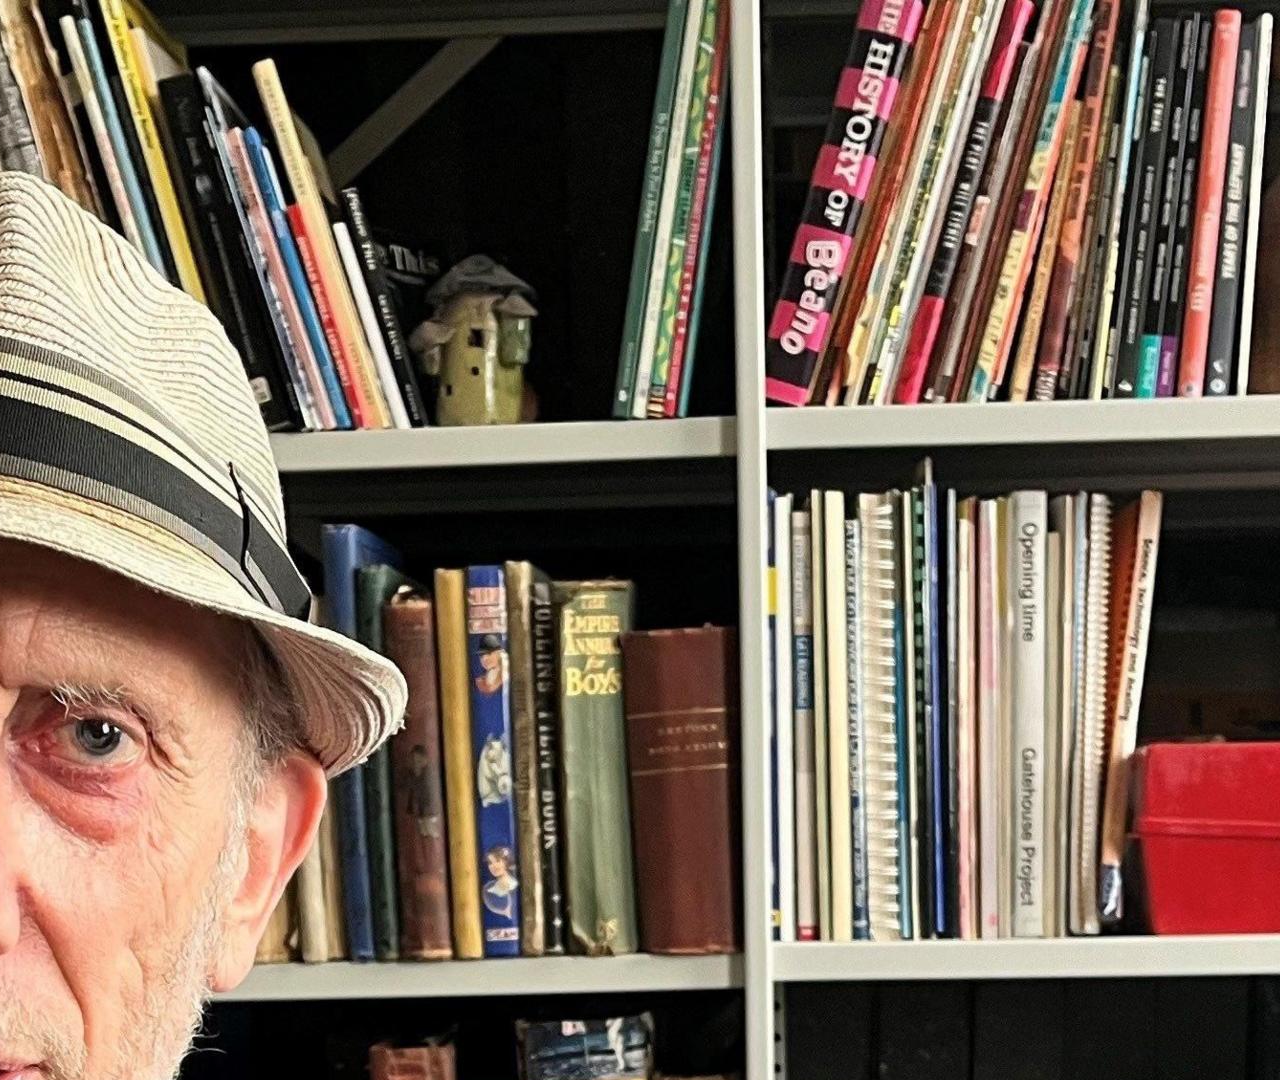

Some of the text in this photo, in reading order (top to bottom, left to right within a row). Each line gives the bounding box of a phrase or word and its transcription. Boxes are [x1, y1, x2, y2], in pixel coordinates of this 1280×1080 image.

[834, 39, 896, 188] HISTORY
[824, 190, 849, 228] OF
[779, 239, 842, 356] Beano
[1019, 522, 1038, 643] Opening time
[533, 599, 553, 692] OLLINS
[1127, 652, 1139, 673] and
[1020, 747, 1038, 907] Gatehouse Project
